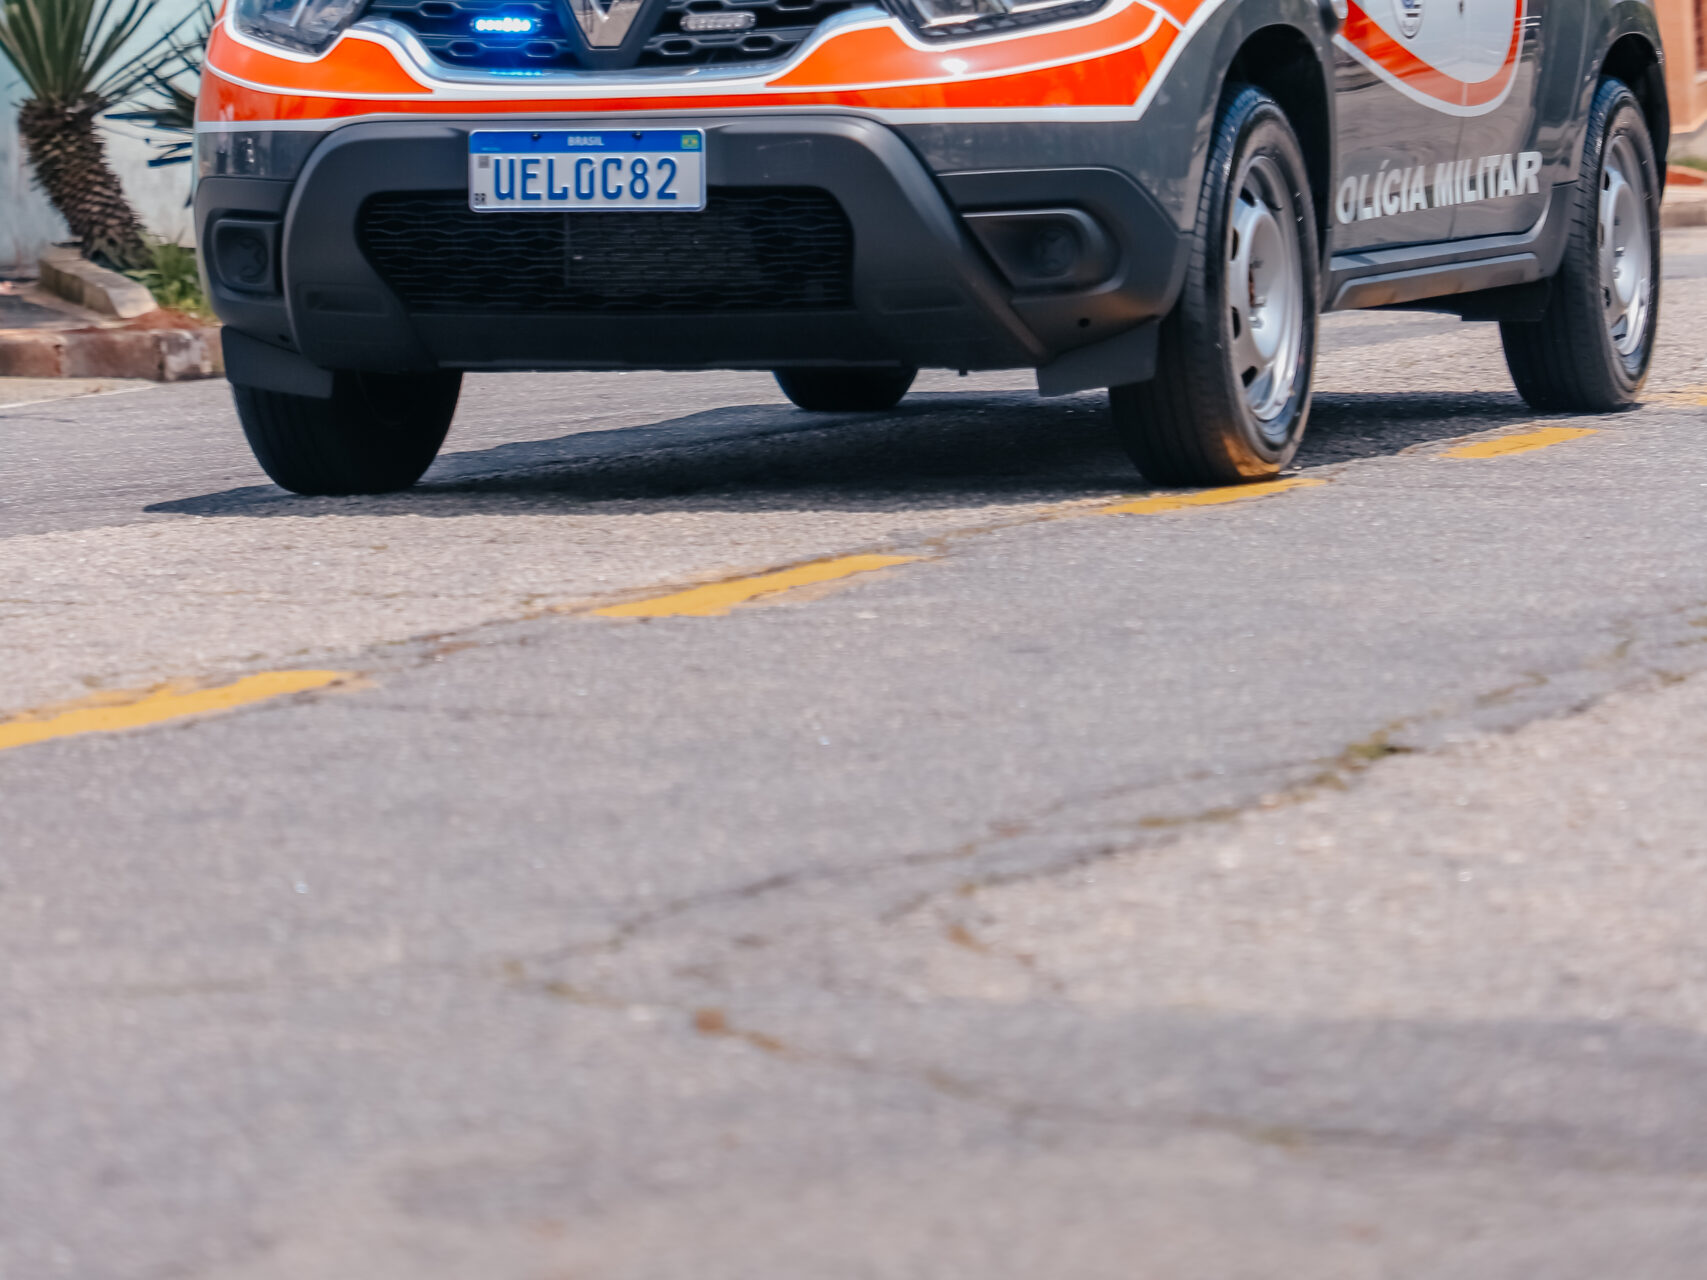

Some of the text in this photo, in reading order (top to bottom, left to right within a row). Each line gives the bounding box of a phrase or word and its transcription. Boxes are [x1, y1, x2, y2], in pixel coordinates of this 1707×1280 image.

[567, 135, 605, 147] BRASIL
[1335, 151, 1543, 224] OLÍCIA MILITAR
